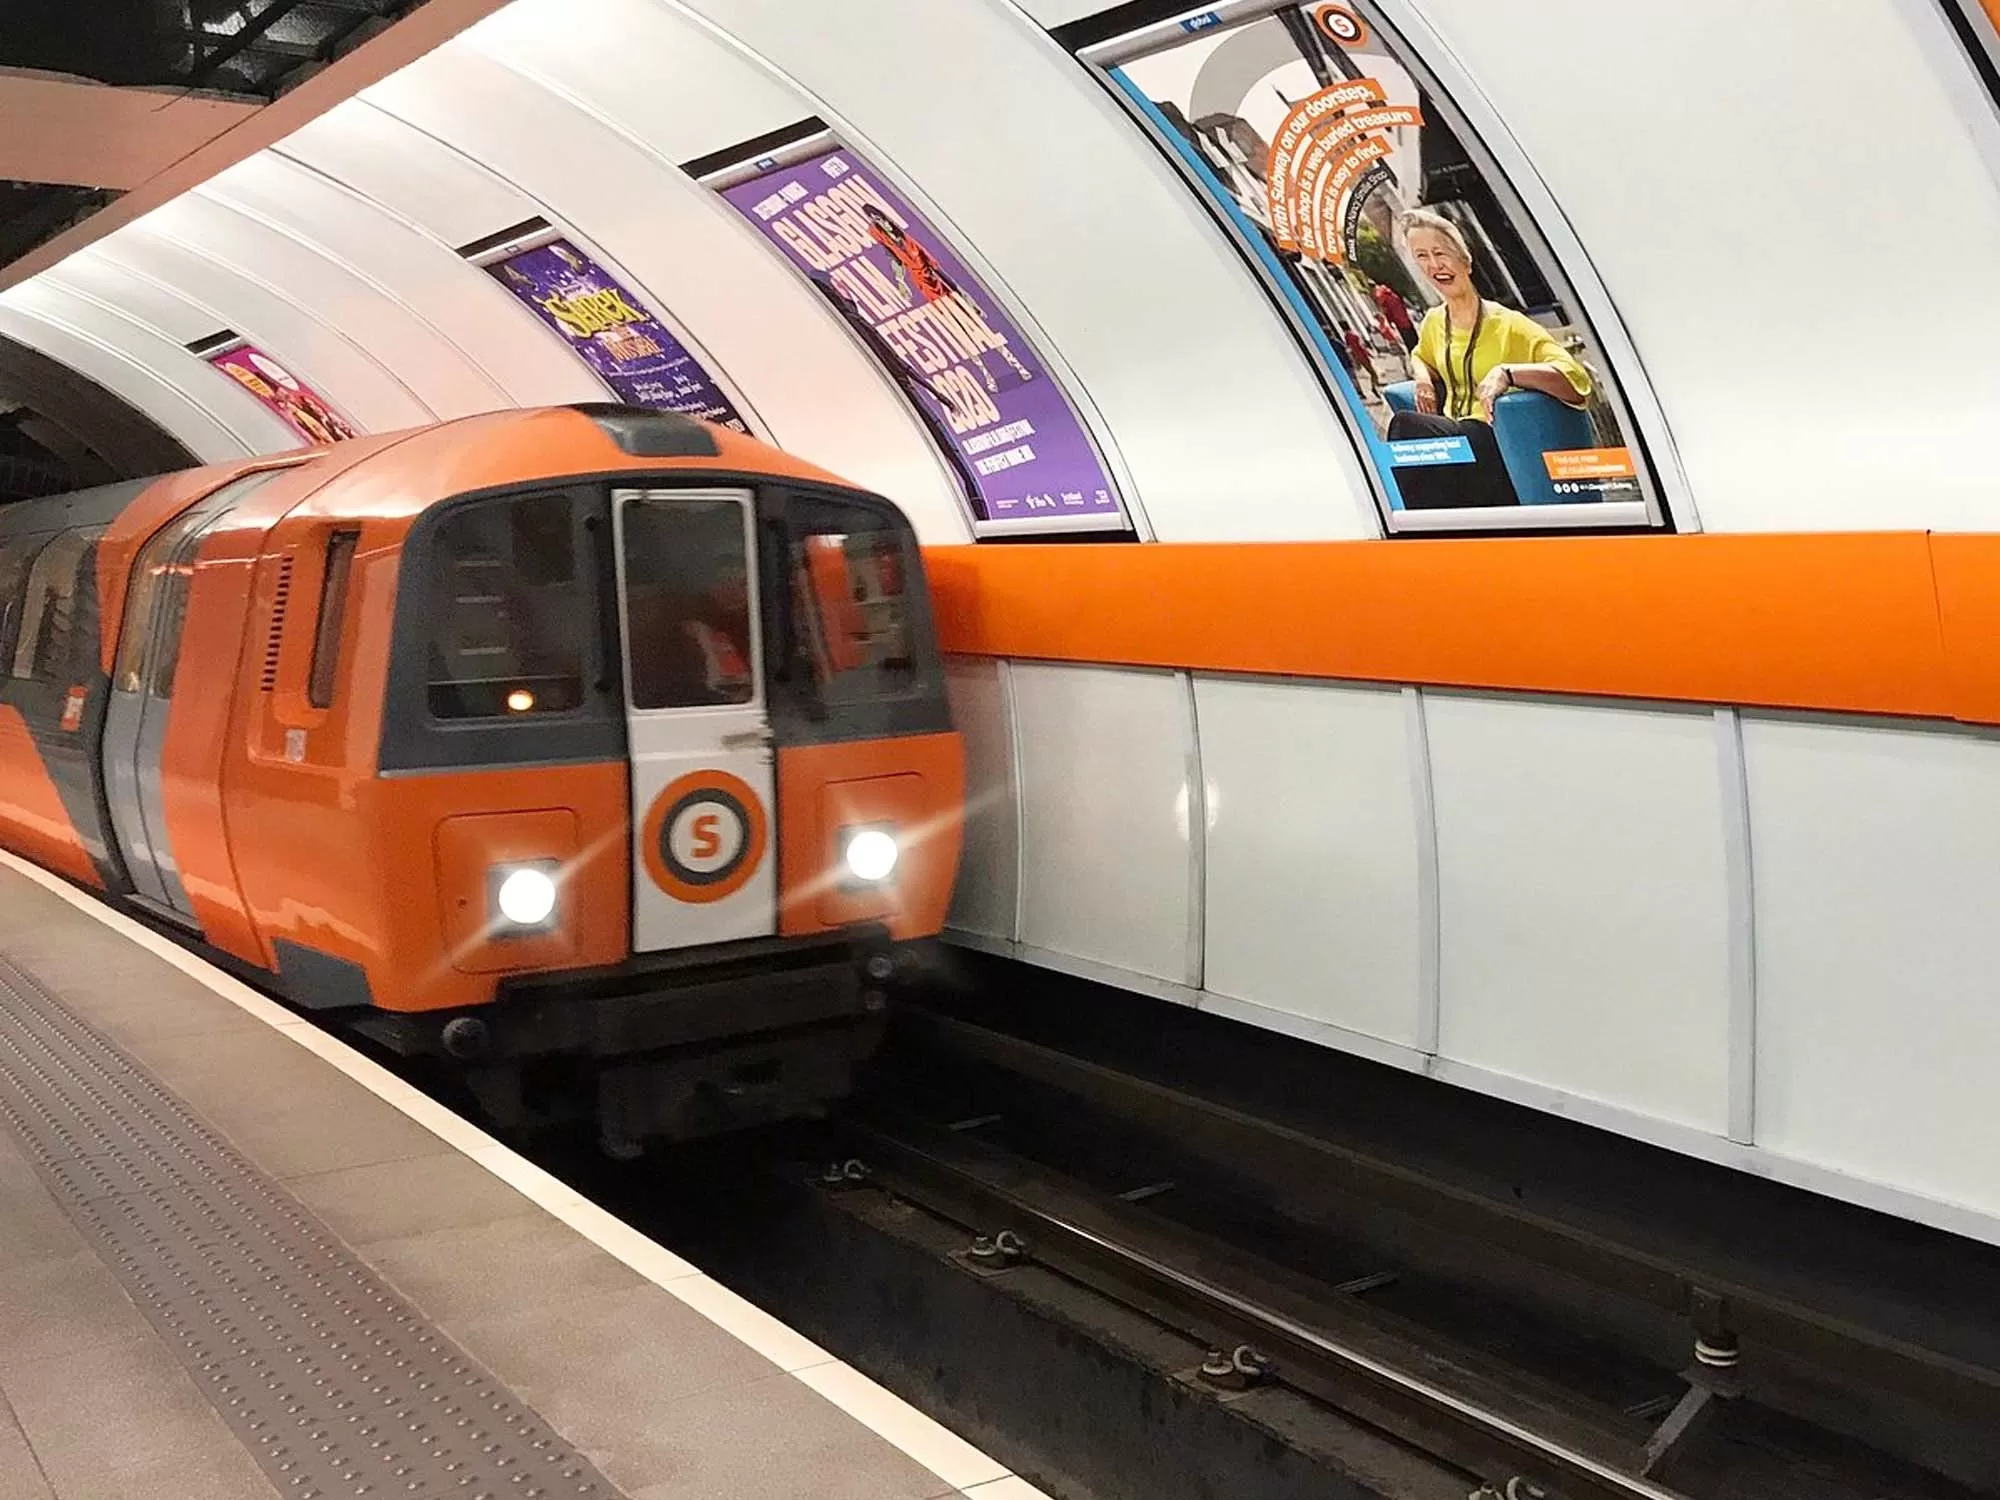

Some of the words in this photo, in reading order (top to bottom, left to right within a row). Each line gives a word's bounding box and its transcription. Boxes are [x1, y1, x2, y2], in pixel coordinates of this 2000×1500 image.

[1350, 111, 1415, 129] treasure
[1270, 146, 1291, 204] Subway
[1281, 131, 1297, 149] on
[1289, 113, 1311, 134] our
[1305, 85, 1376, 116] doorstep,
[1317, 121, 1355, 150] buried
[1305, 147, 1326, 171] wee
[1344, 155, 1361, 169] to
[1354, 141, 1385, 161] find.
[1297, 178, 1313, 193] is
[1303, 169, 1315, 181] a
[1331, 163, 1353, 190] easy
[1325, 185, 1340, 199] is
[1297, 192, 1313, 225] shop
[1322, 195, 1336, 222] that
[772, 174, 909, 271] GLASGOW
[1302, 224, 1316, 249] the
[1324, 221, 1338, 254] trove
[829, 255, 912, 325] FILM
[535, 287, 649, 338] SHREK
[875, 292, 1008, 375] FESTIVAL
[691, 814, 721, 859] S
